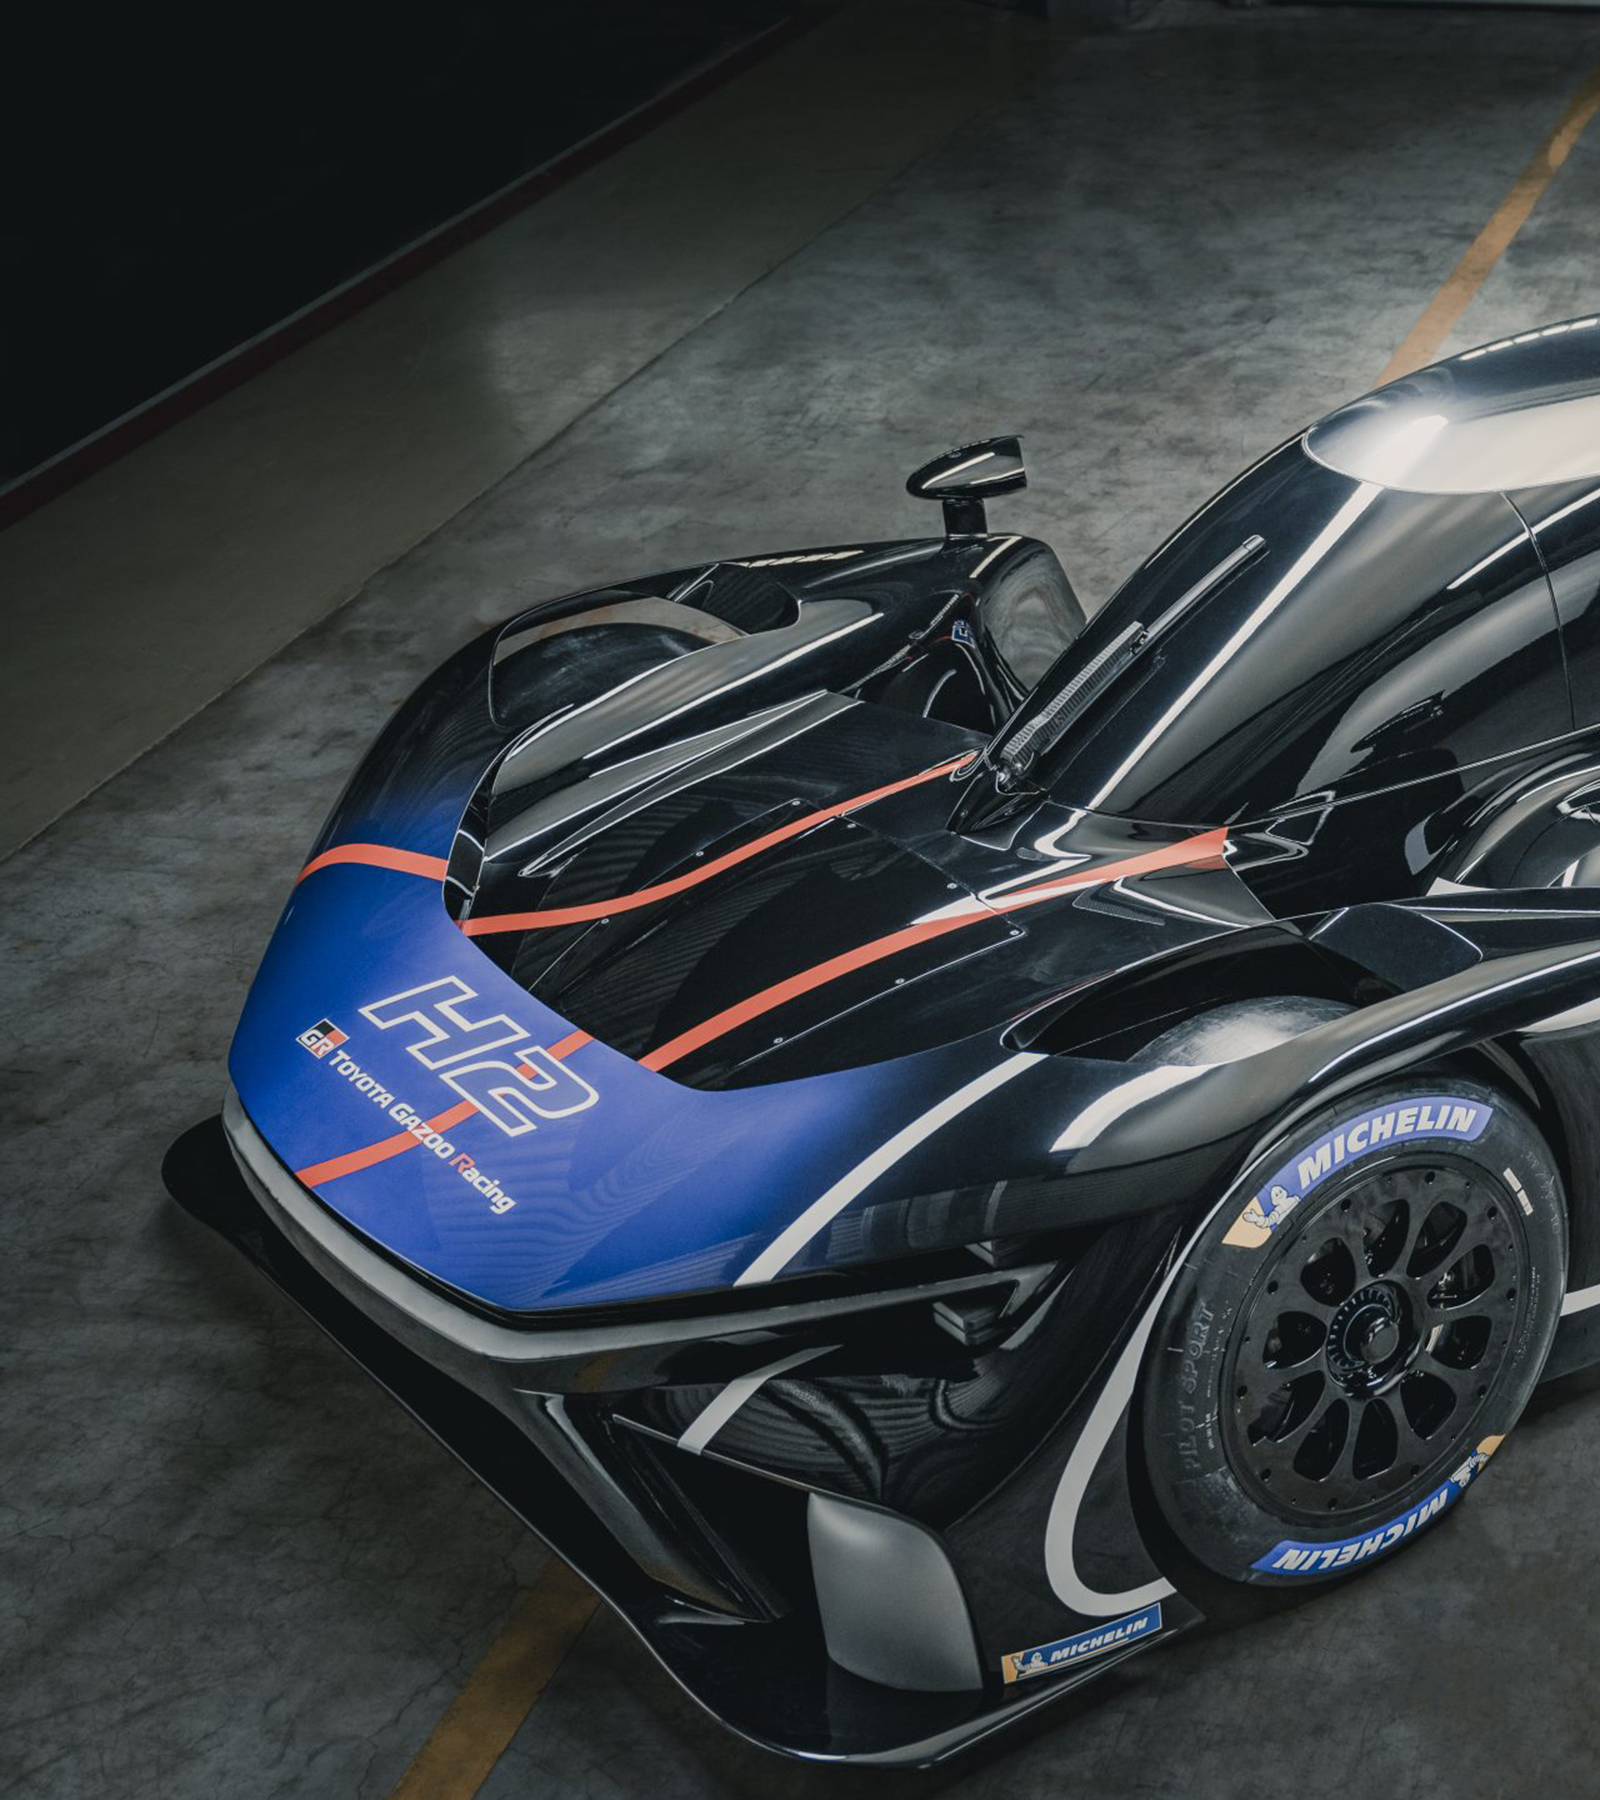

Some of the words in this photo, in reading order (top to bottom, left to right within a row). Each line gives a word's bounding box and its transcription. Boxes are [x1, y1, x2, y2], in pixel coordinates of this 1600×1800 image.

[357, 975, 600, 1137] H2
[329, 1050, 396, 1108] TOYOTA
[389, 1103, 456, 1159] GAZOO
[449, 1153, 516, 1214] Racing
[1297, 1105, 1478, 1190] MICHELIN
[1183, 1300, 1214, 1394] SPORT
[1272, 1488, 1448, 1571] MICHELIN
[1051, 1617, 1148, 1662] MICHELIN
